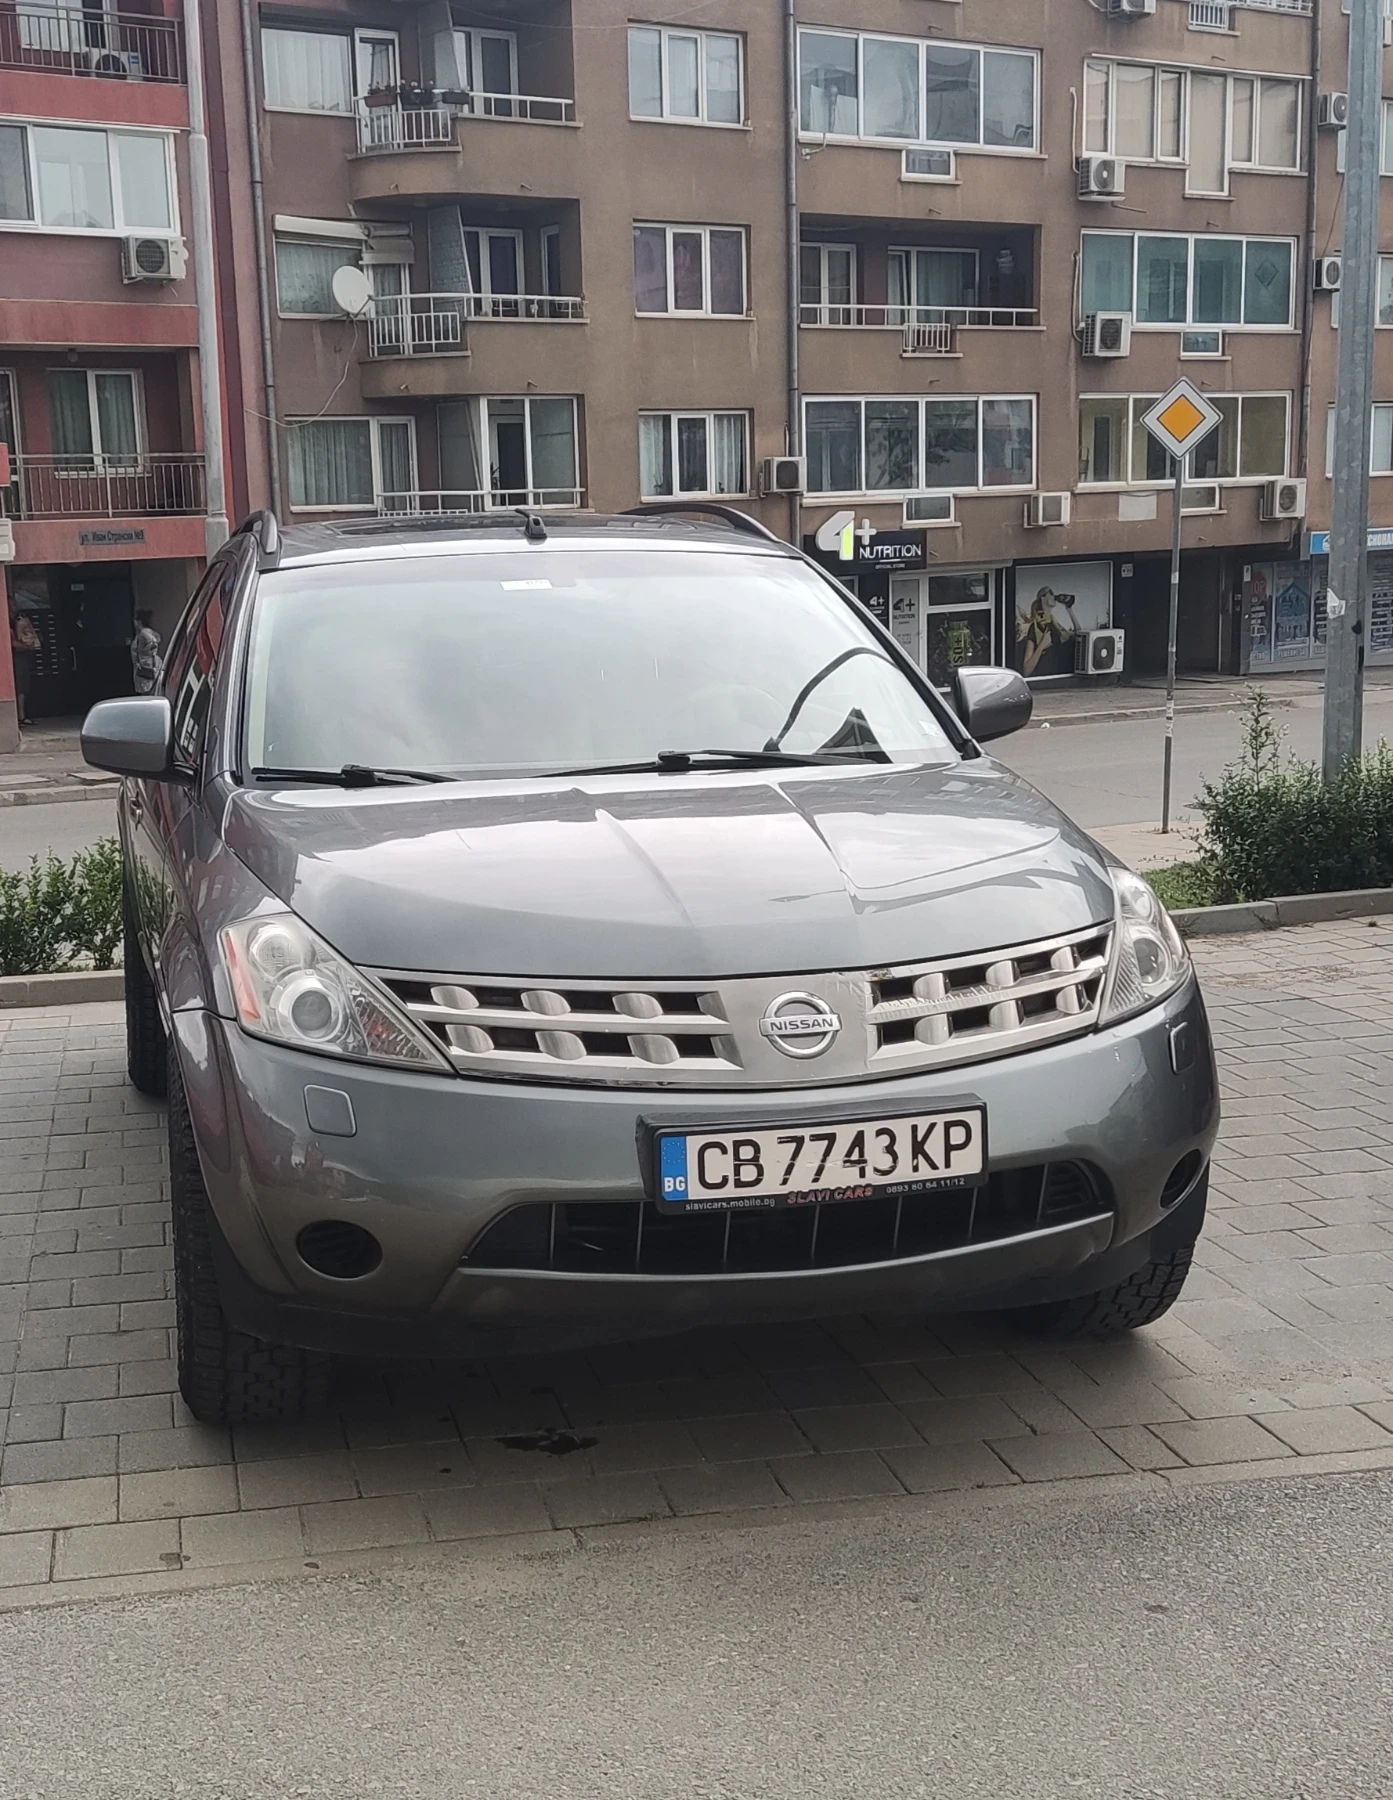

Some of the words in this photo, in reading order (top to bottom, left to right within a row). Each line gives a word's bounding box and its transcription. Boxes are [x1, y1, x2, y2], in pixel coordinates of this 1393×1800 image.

[815, 510, 877, 560] 4+
[859, 544, 922, 559] NUTRITION
[870, 596, 885, 605] 4+
[893, 598, 915, 613] 4+
[770, 1018, 833, 1032] NISSAN
[698, 1138, 764, 1190] CB
[777, 1127, 899, 1186] 7743
[911, 1119, 972, 1173] KP
[663, 1177, 685, 1193] BG
[886, 1184, 909, 1194] 0893
[940, 1177, 965, 1187] 11/12
[787, 1190, 830, 1205] SLAVI
[834, 1186, 873, 1200] CARS
[685, 1198, 775, 1211] slavicars.mobile.bg
